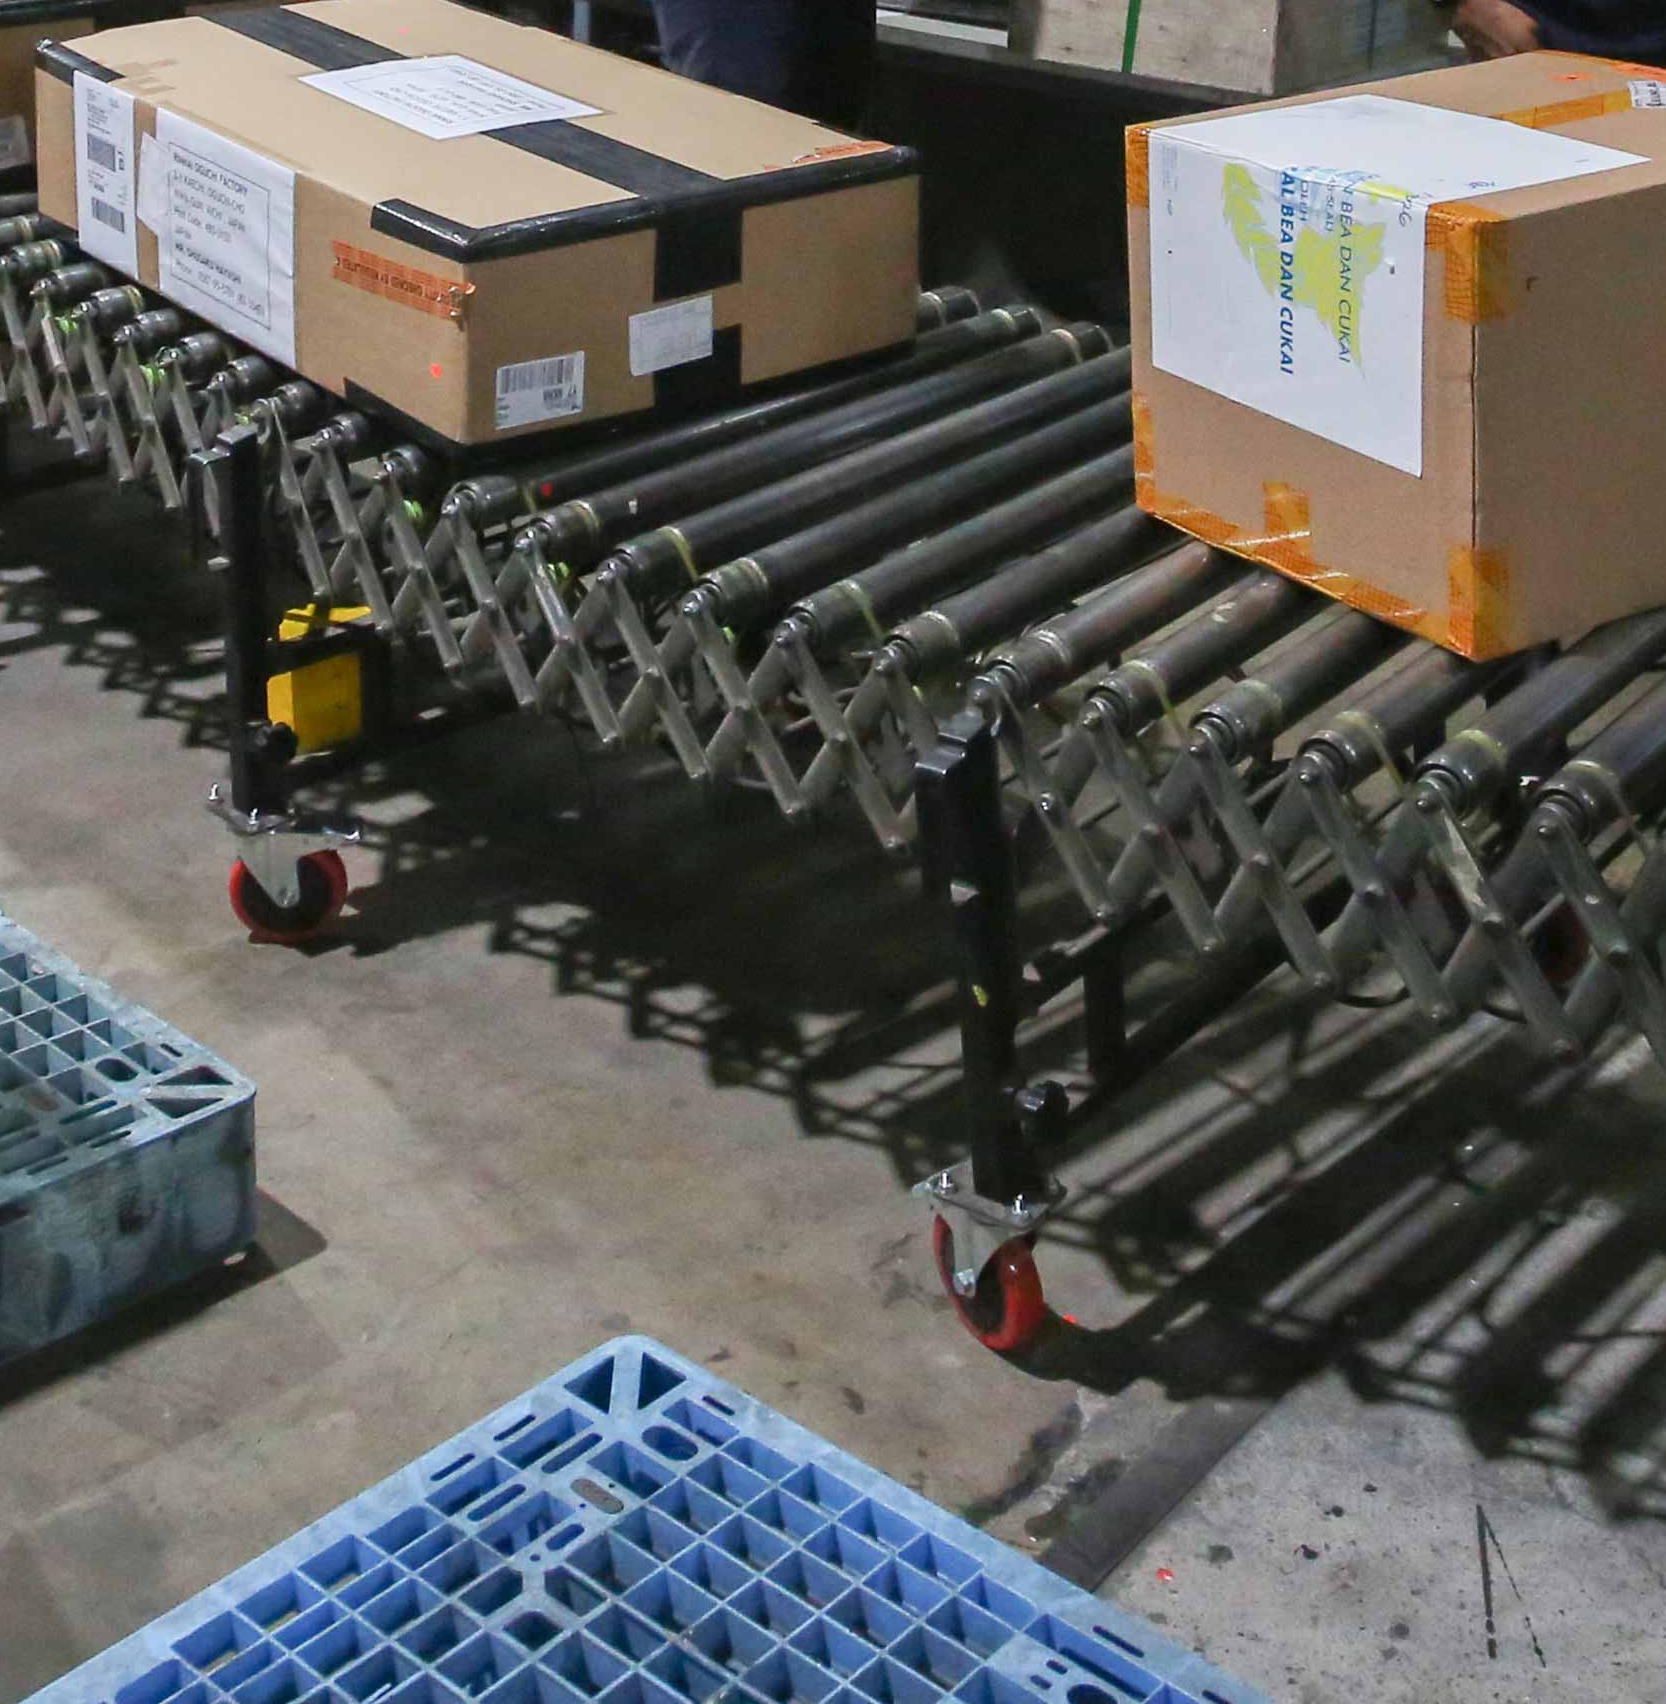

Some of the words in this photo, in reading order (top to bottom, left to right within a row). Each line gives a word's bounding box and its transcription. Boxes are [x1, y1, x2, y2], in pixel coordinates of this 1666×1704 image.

[219, 173, 248, 197] FACTORY
[1280, 203, 1294, 244] BEA
[1340, 200, 1353, 239] BEA
[1279, 250, 1294, 301] DAN
[1339, 246, 1353, 293] DAN
[1279, 306, 1294, 375] CUKAI
[1338, 299, 1353, 364] CUKAI
